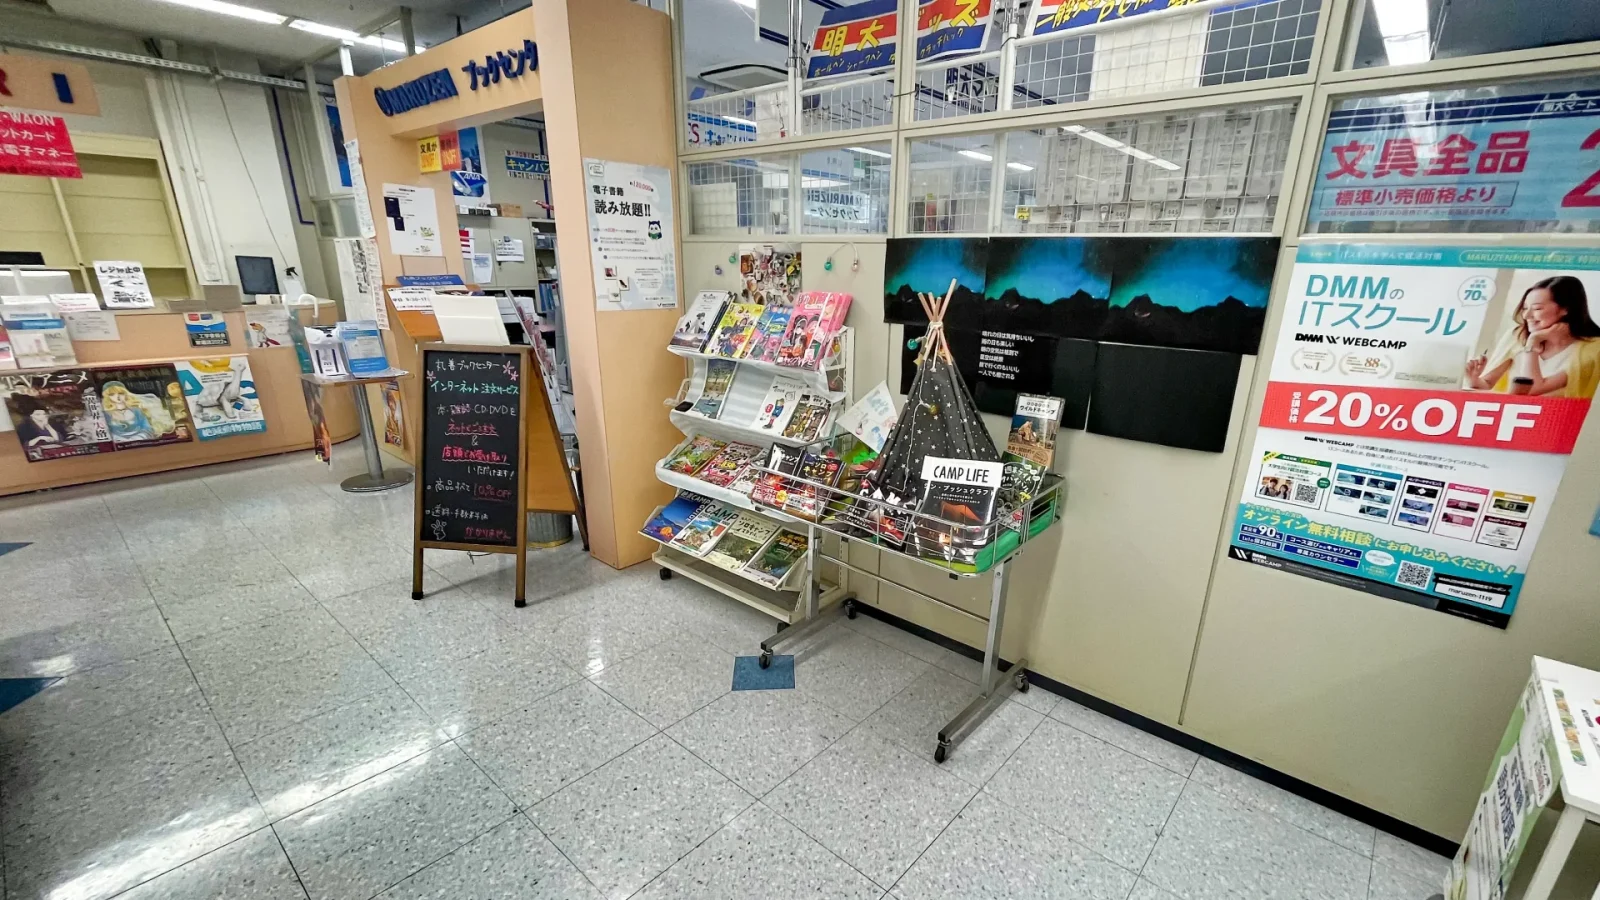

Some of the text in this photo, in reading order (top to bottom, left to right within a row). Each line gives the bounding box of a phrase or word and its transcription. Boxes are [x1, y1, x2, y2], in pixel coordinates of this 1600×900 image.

[1325, 130, 1530, 180] 文具全品
[463, 172, 481, 181] ANA
[592, 184, 624, 197] 電子書籍
[1335, 186, 1496, 206] 標準小売価格より
[593, 199, 651, 217] 読み放題!!
[1305, 274, 1405, 300] DMMの
[1298, 300, 1467, 336] ITスクール
[1342, 337, 1408, 350] WEBCAMP
[435, 358, 500, 371] 丸善ブックセンター
[430, 380, 519, 395] インターネット 注文サービス
[1303, 389, 1542, 443] 20%OFF
[471, 434, 479, 446] &
[933, 466, 964, 481] CAMP
[966, 468, 989, 483] LIFE
[704, 504, 740, 522] CAMP
